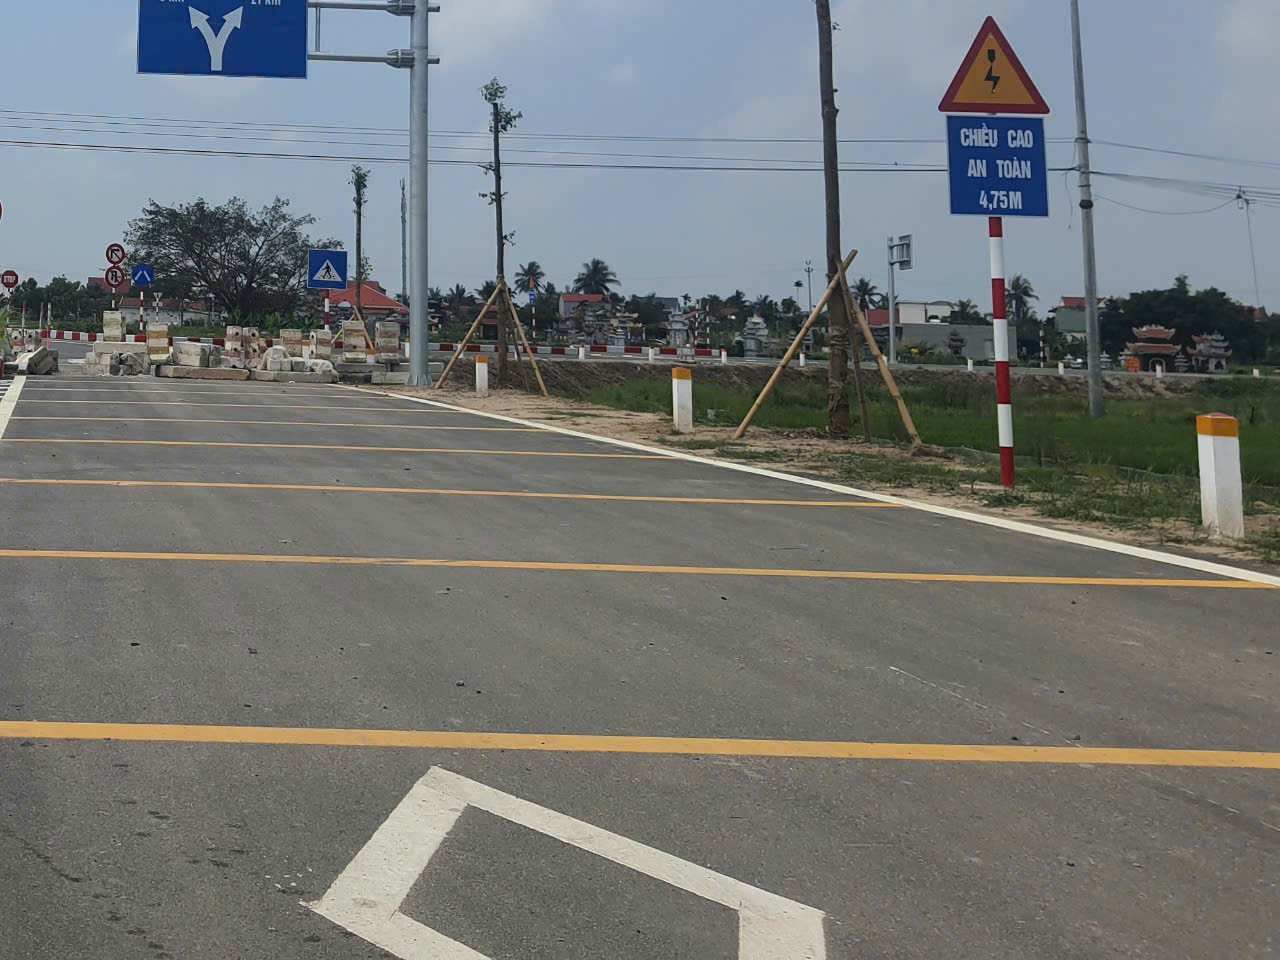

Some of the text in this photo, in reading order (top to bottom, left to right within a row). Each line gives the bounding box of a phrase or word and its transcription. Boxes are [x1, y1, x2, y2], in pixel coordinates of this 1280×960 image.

[960, 122, 1033, 149] CHIỀU CAO
[967, 156, 1031, 179] AN TOÀN
[979, 190, 1022, 211] 4,75M
[4, 275, 16, 283] STOP
